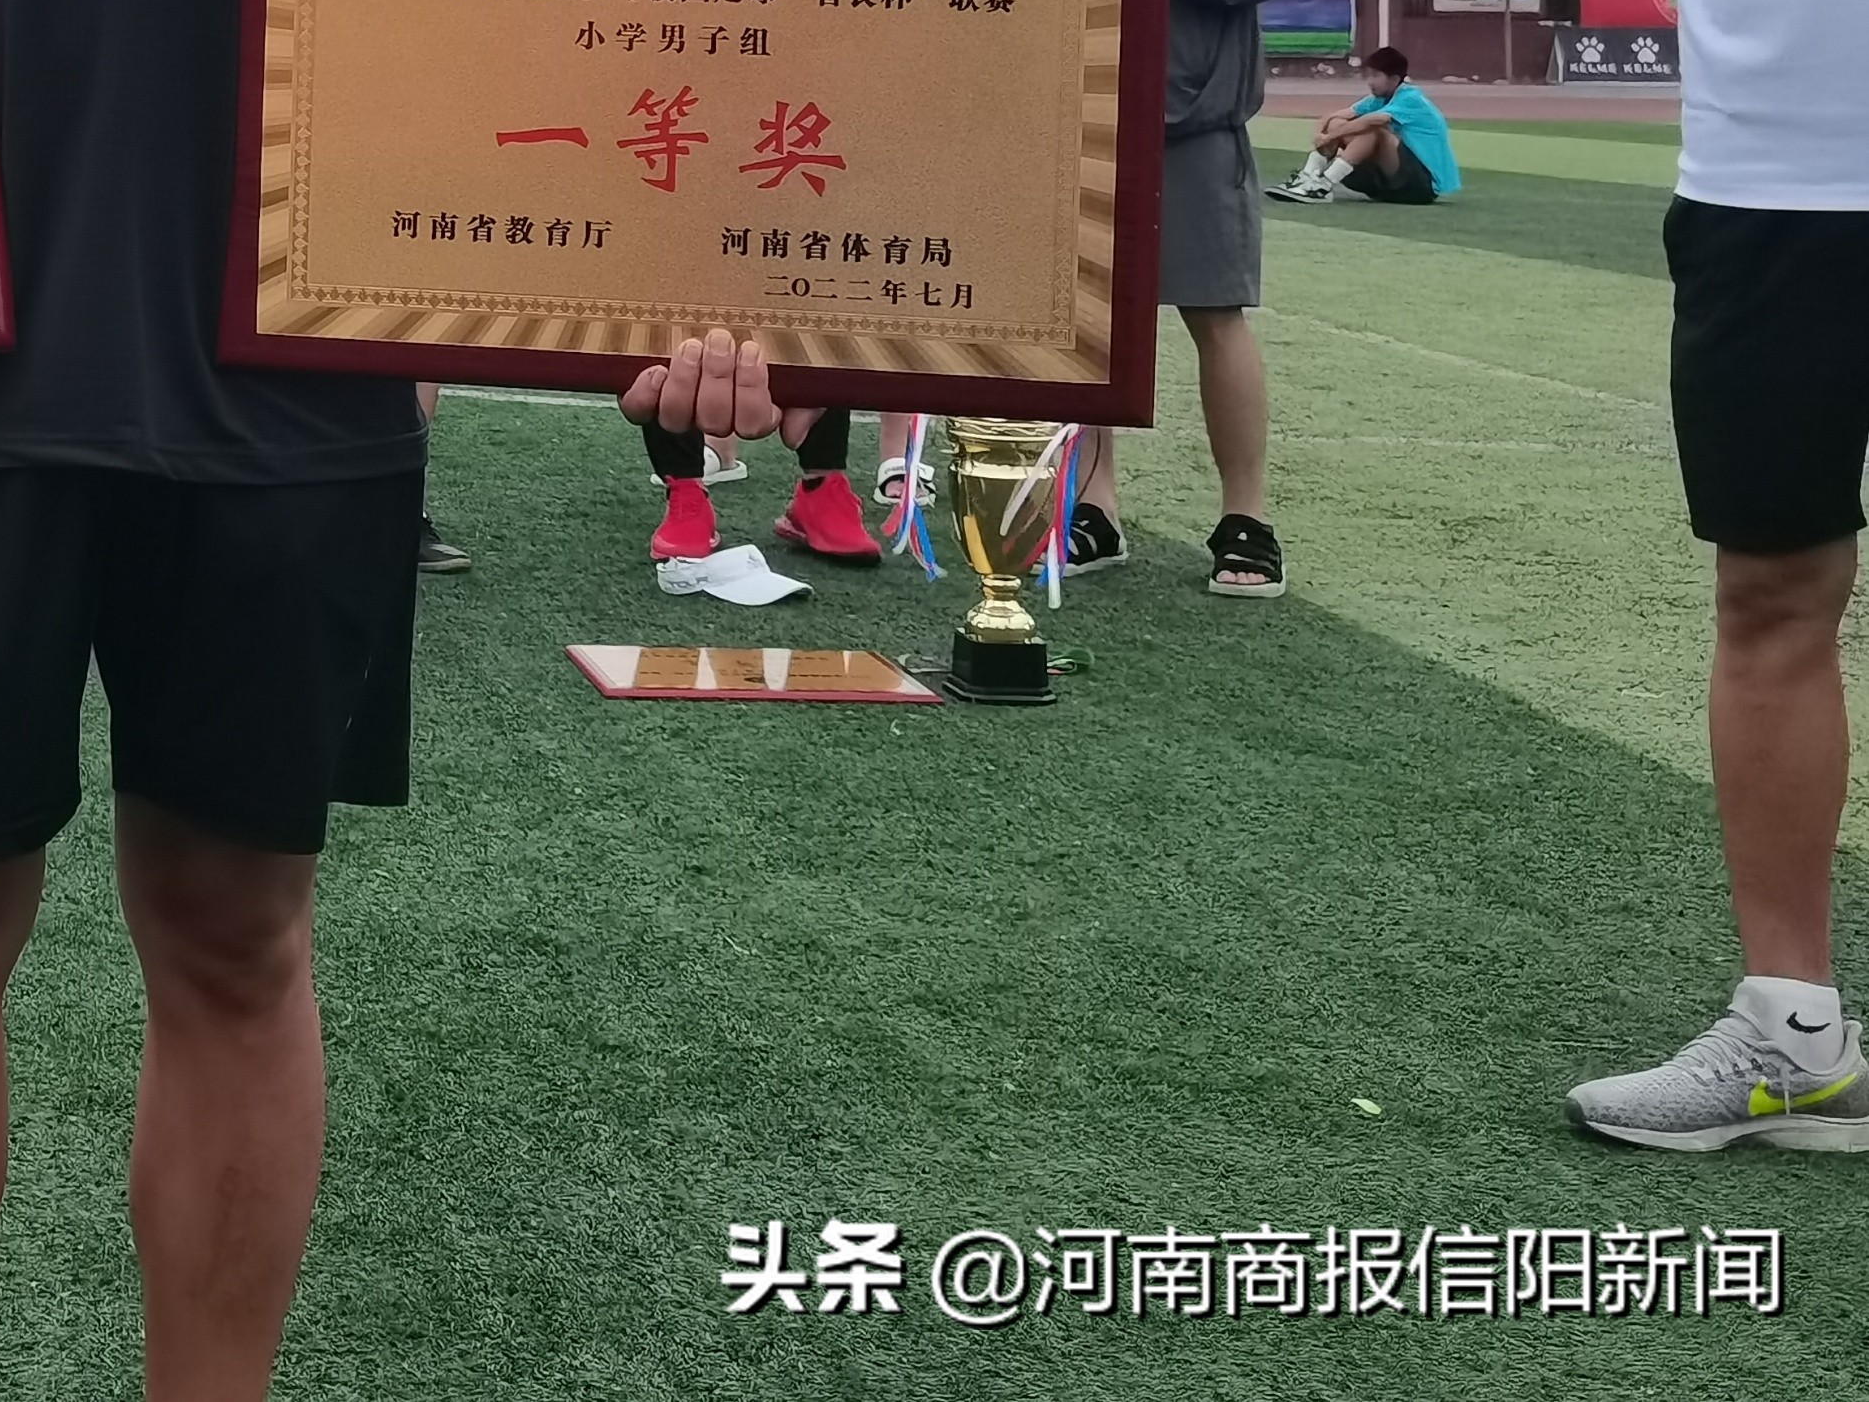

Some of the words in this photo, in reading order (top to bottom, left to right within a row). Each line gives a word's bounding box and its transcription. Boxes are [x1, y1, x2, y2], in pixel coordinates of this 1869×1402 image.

[574, 20, 771, 57] 小学男子组
[495, 84, 847, 198] 一等奖
[391, 210, 613, 250] 河南省教育厅
[721, 226, 952, 268] 河南省体育局
